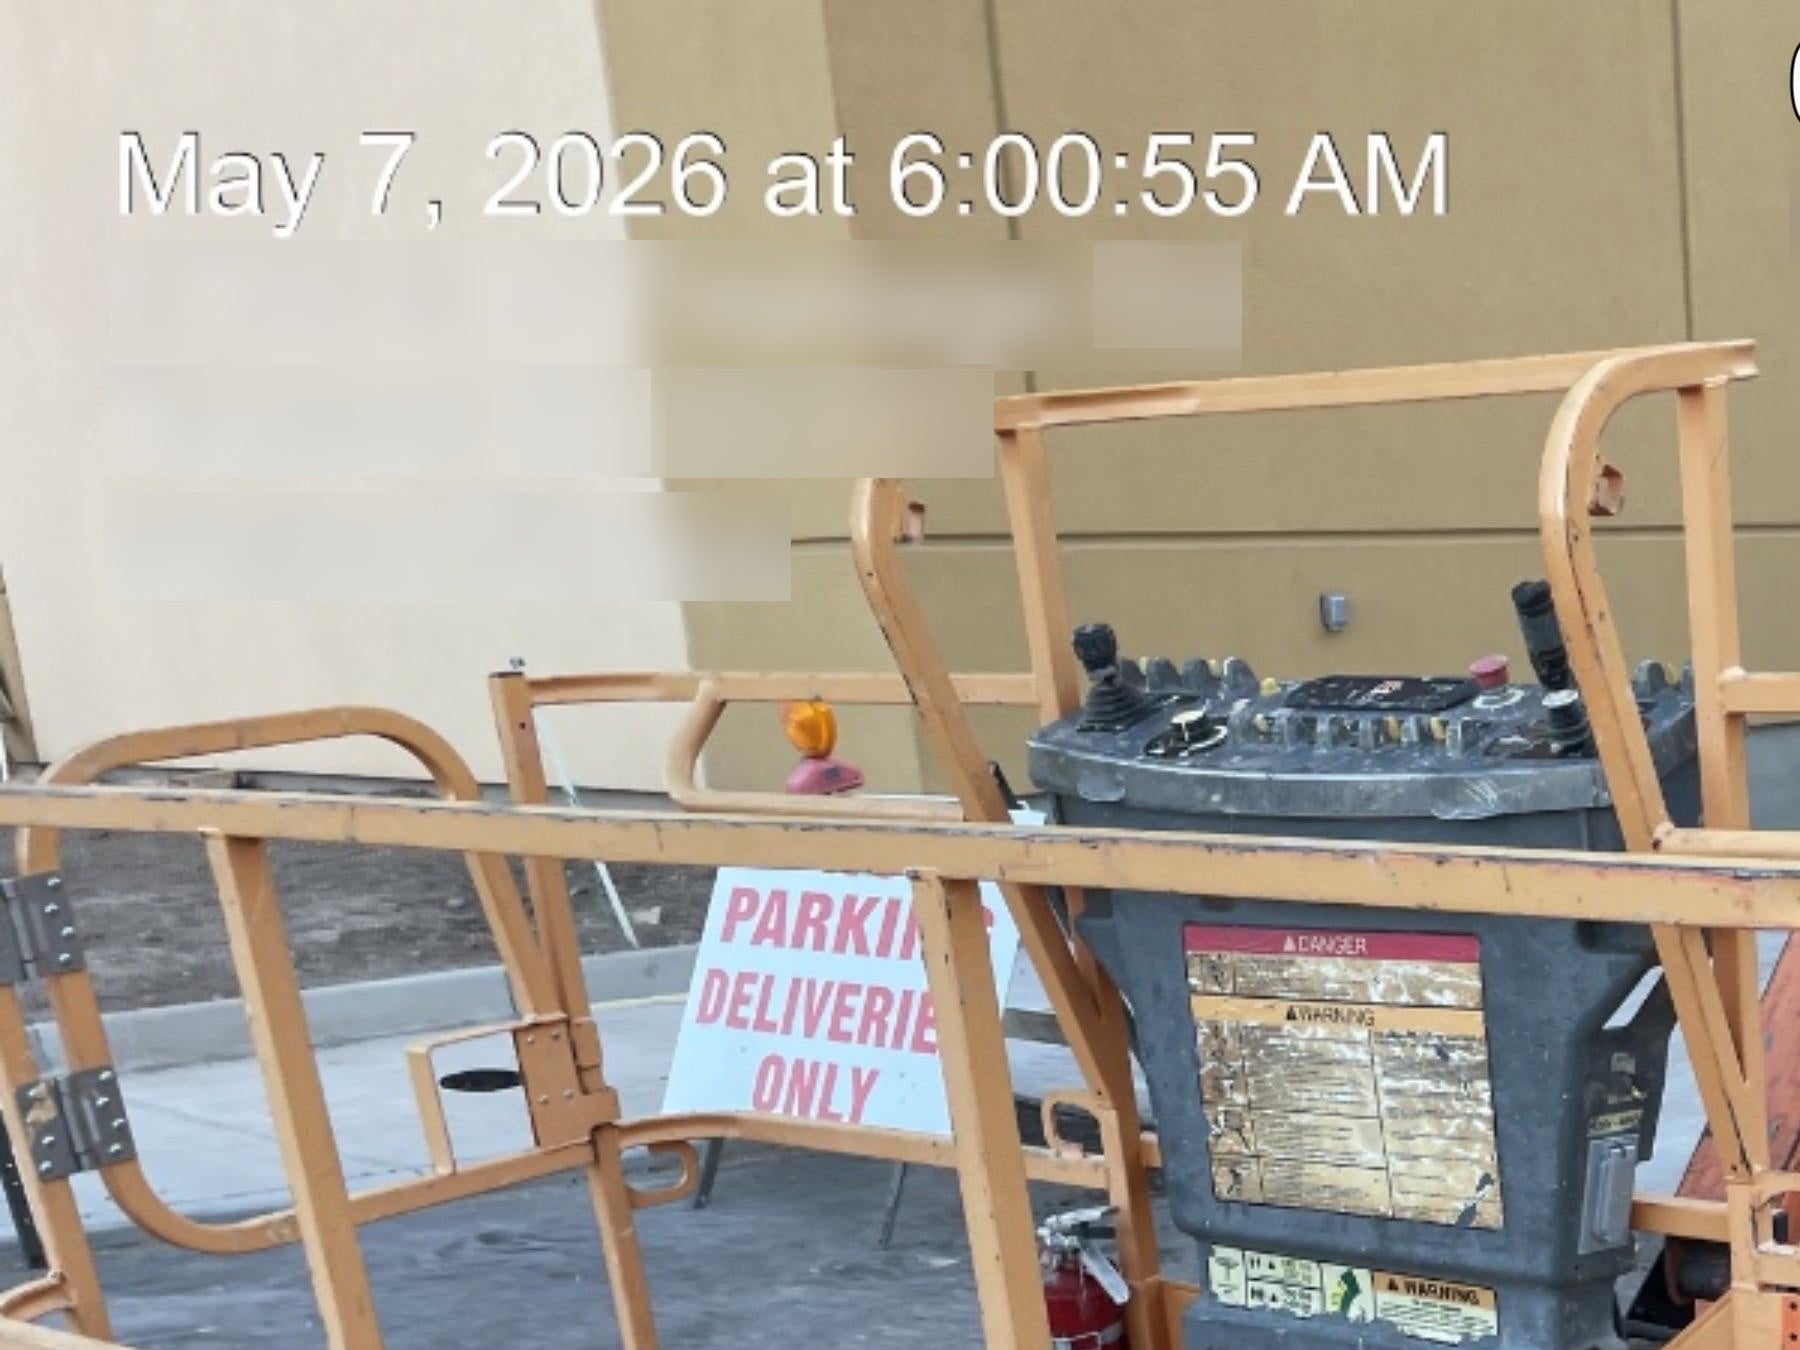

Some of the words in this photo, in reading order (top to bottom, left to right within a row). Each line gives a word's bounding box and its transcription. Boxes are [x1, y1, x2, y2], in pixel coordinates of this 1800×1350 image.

[719, 886, 993, 961] PARKI
[1298, 935, 1369, 955] DANGER
[695, 967, 939, 1055] DELIVERIE
[1299, 1006, 1376, 1027] WARNING
[752, 1052, 881, 1124] ONLY
[1404, 1279, 1480, 1305] WARNING
